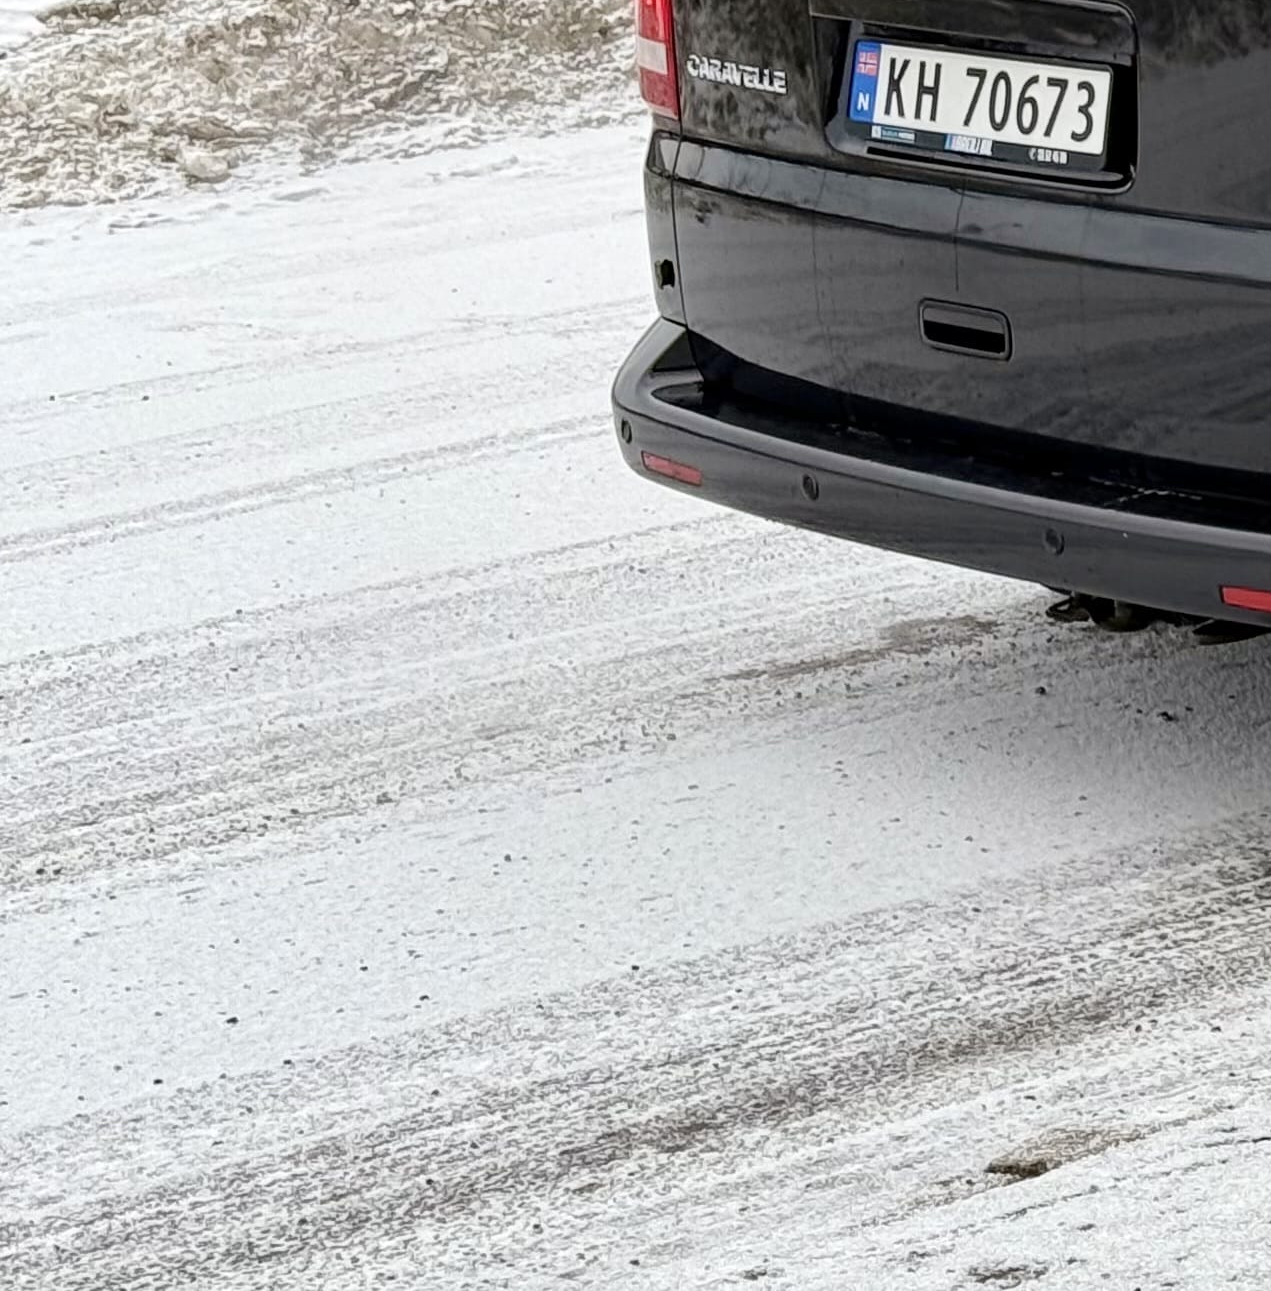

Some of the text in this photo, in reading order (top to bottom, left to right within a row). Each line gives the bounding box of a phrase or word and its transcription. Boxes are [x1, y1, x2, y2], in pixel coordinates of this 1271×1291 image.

[686, 54, 788, 95] CARAVELLE
[857, 92, 870, 112] N
[883, 57, 1096, 143] KH 70673
